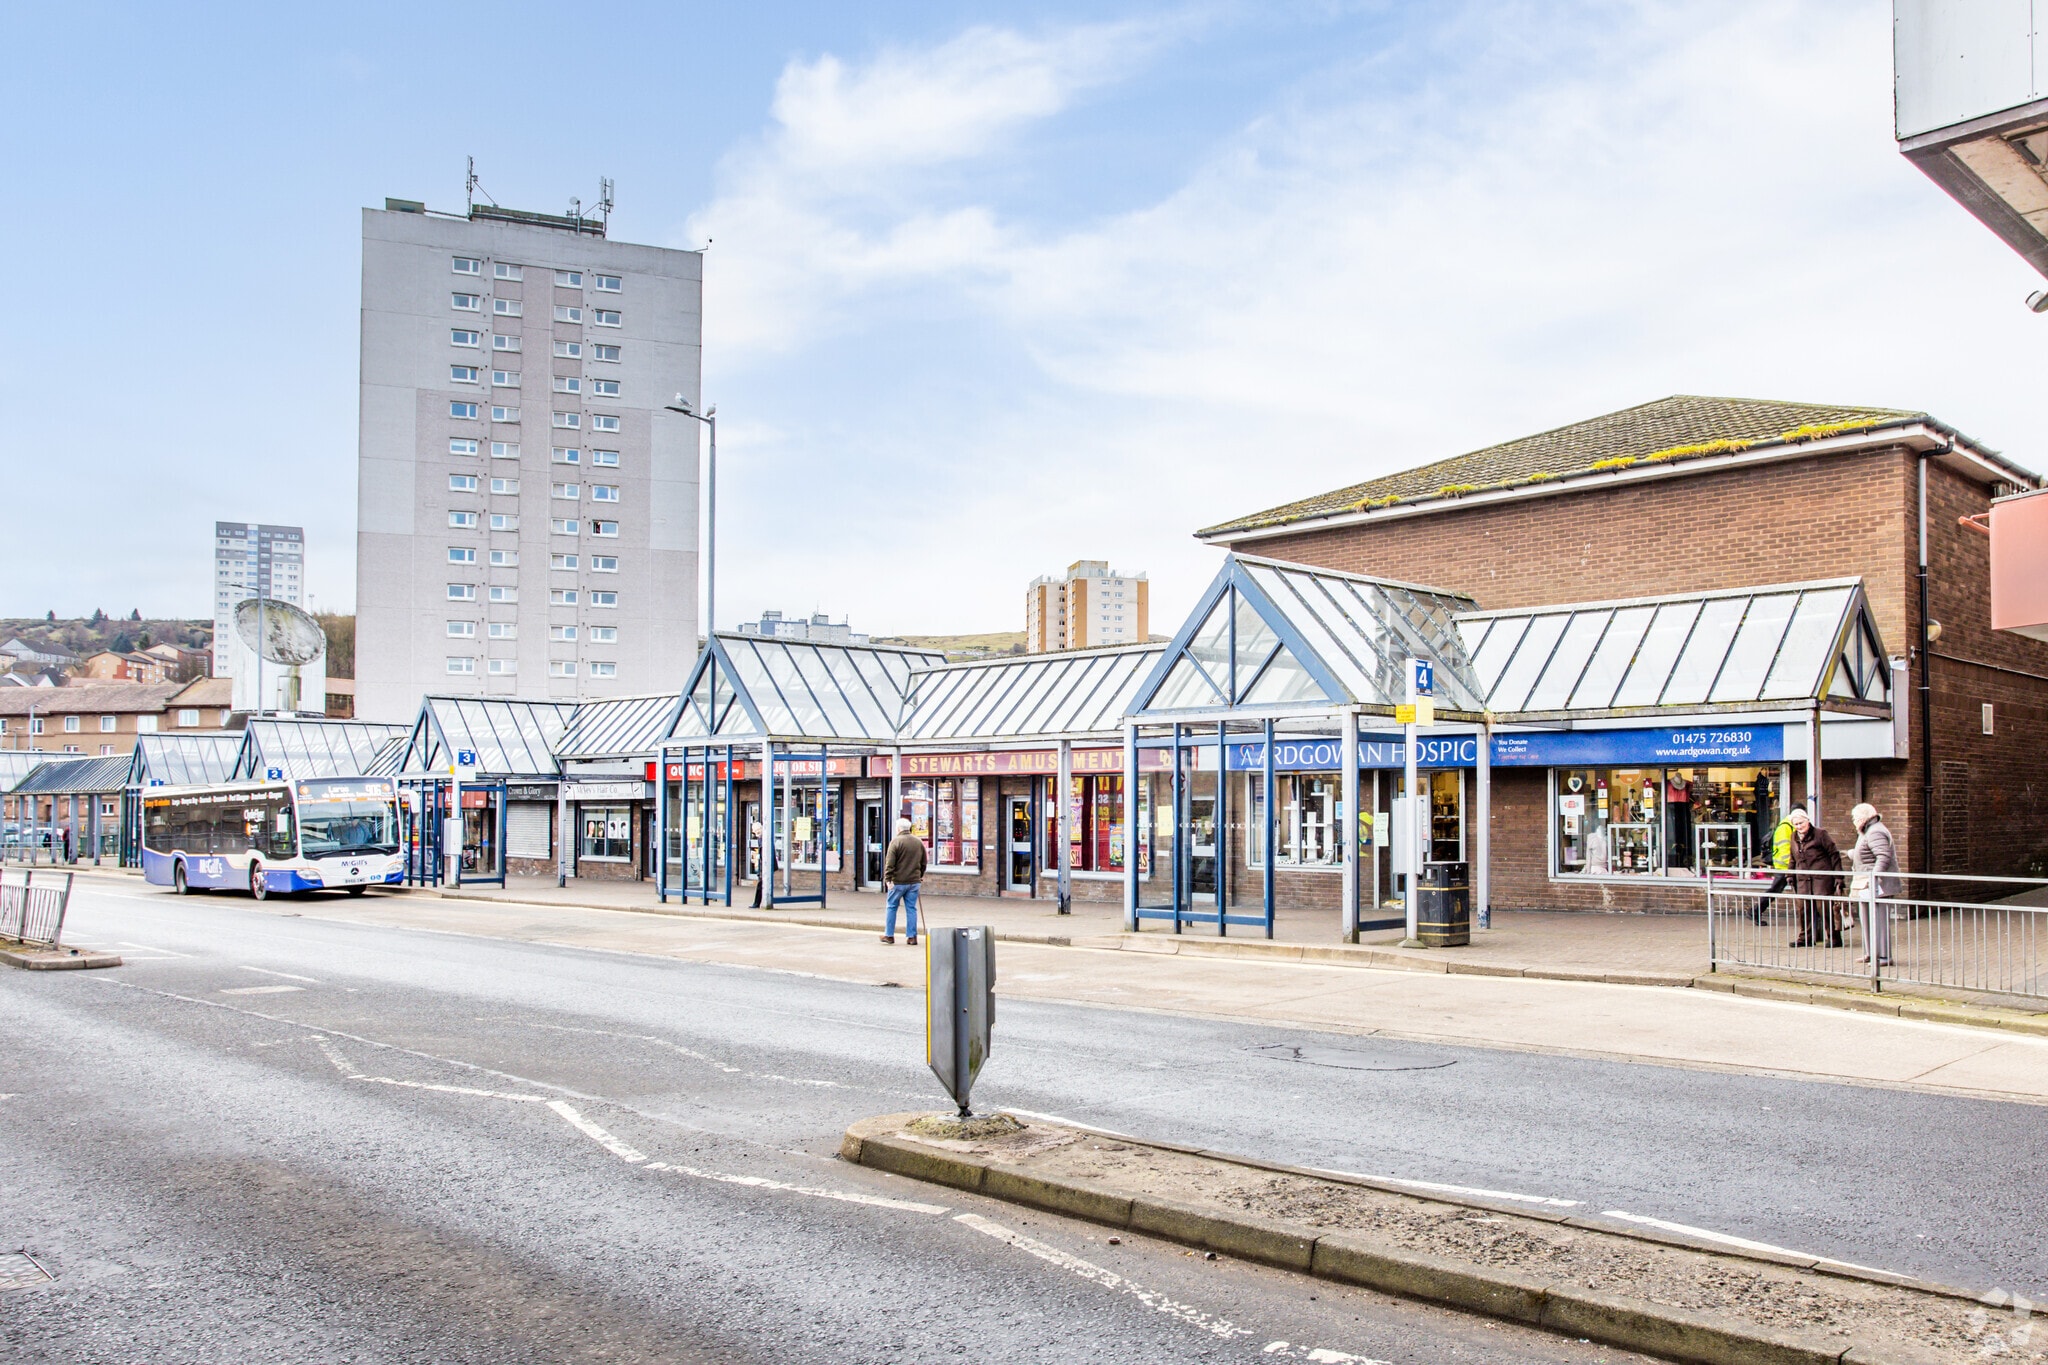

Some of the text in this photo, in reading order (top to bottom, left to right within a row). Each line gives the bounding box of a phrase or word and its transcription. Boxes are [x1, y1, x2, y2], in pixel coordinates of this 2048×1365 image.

[1418, 669, 1428, 687] 4
[1672, 731, 1752, 744] 01475 726830
[1391, 740, 1476, 762] HOSPIC
[1655, 745, 1751, 758] www.ardgowan.org.uk
[463, 753, 471, 763] 3
[909, 755, 996, 773] STEWARTS
[1008, 751, 1125, 770] AMUSMENT
[271, 770, 279, 778] 2
